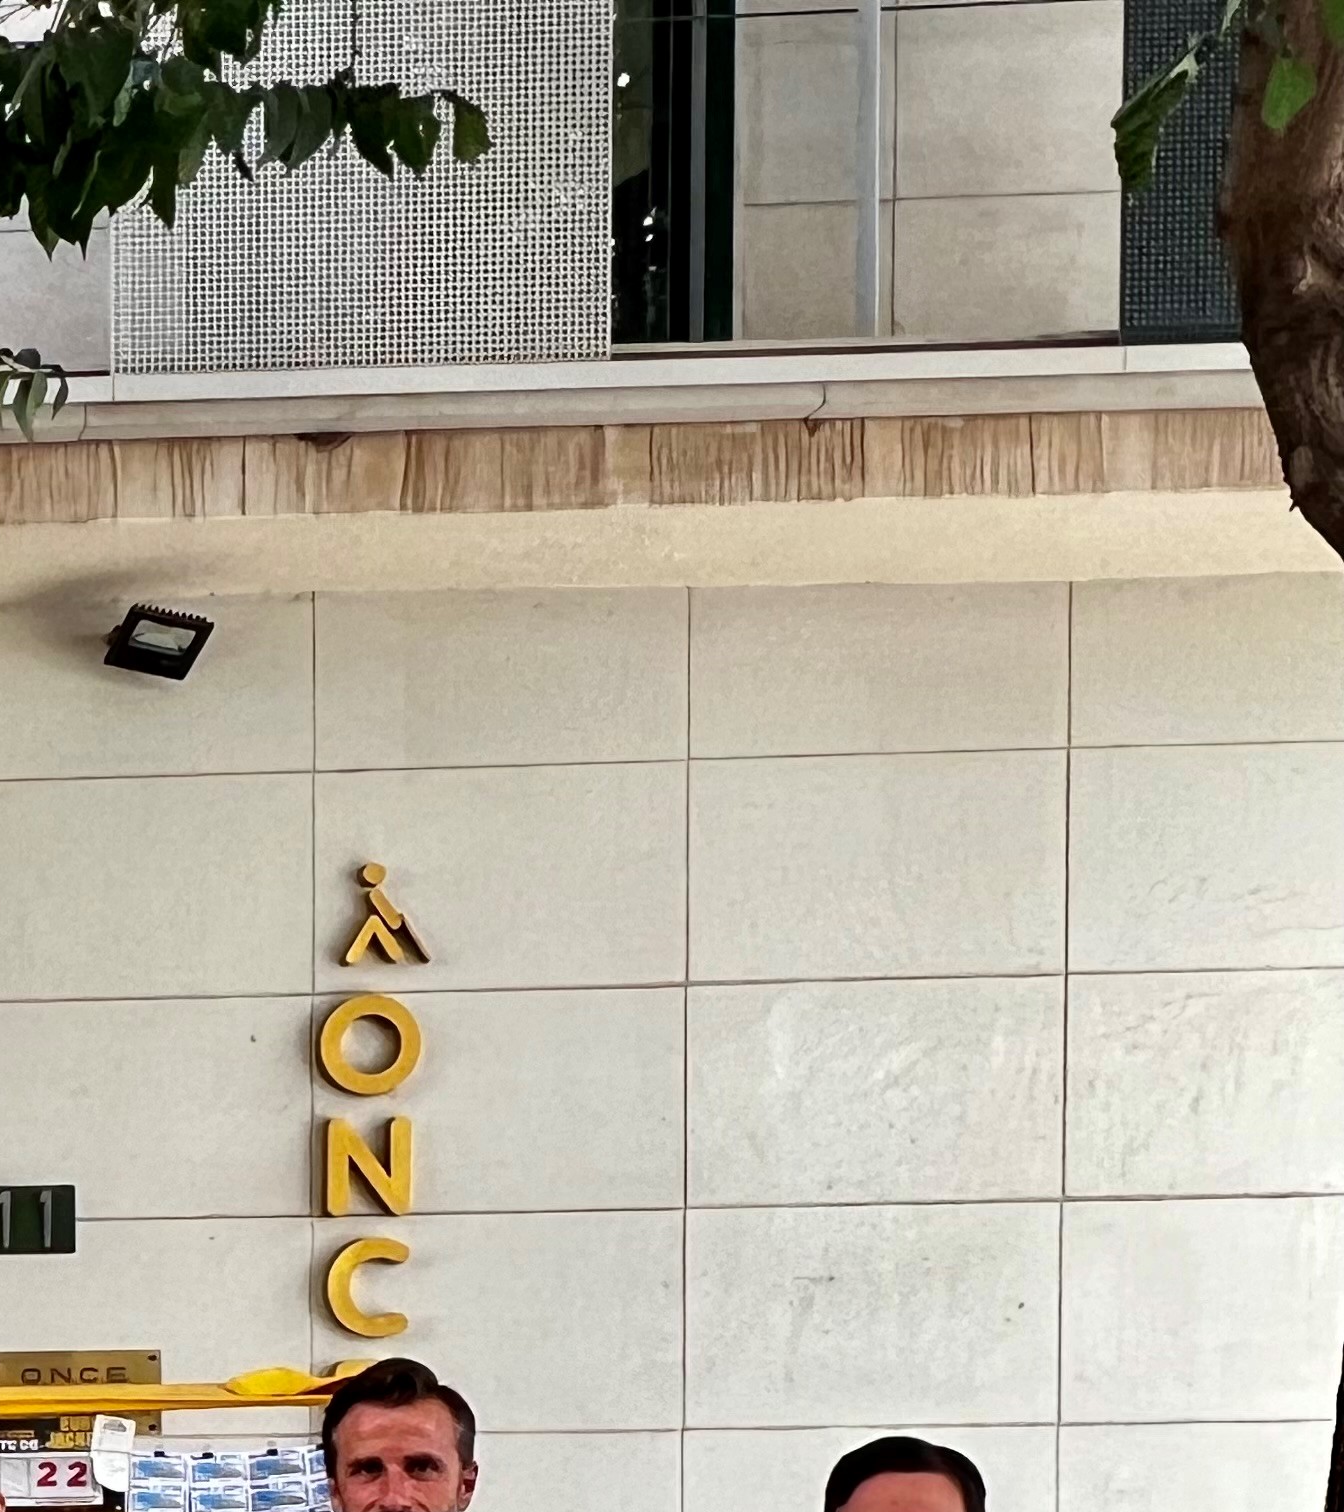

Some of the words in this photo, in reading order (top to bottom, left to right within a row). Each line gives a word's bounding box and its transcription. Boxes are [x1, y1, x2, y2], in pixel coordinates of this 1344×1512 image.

[320, 994, 422, 1377] ONC
[21, 1366, 128, 1384] ONCE
[36, 1461, 88, 1487] 22
